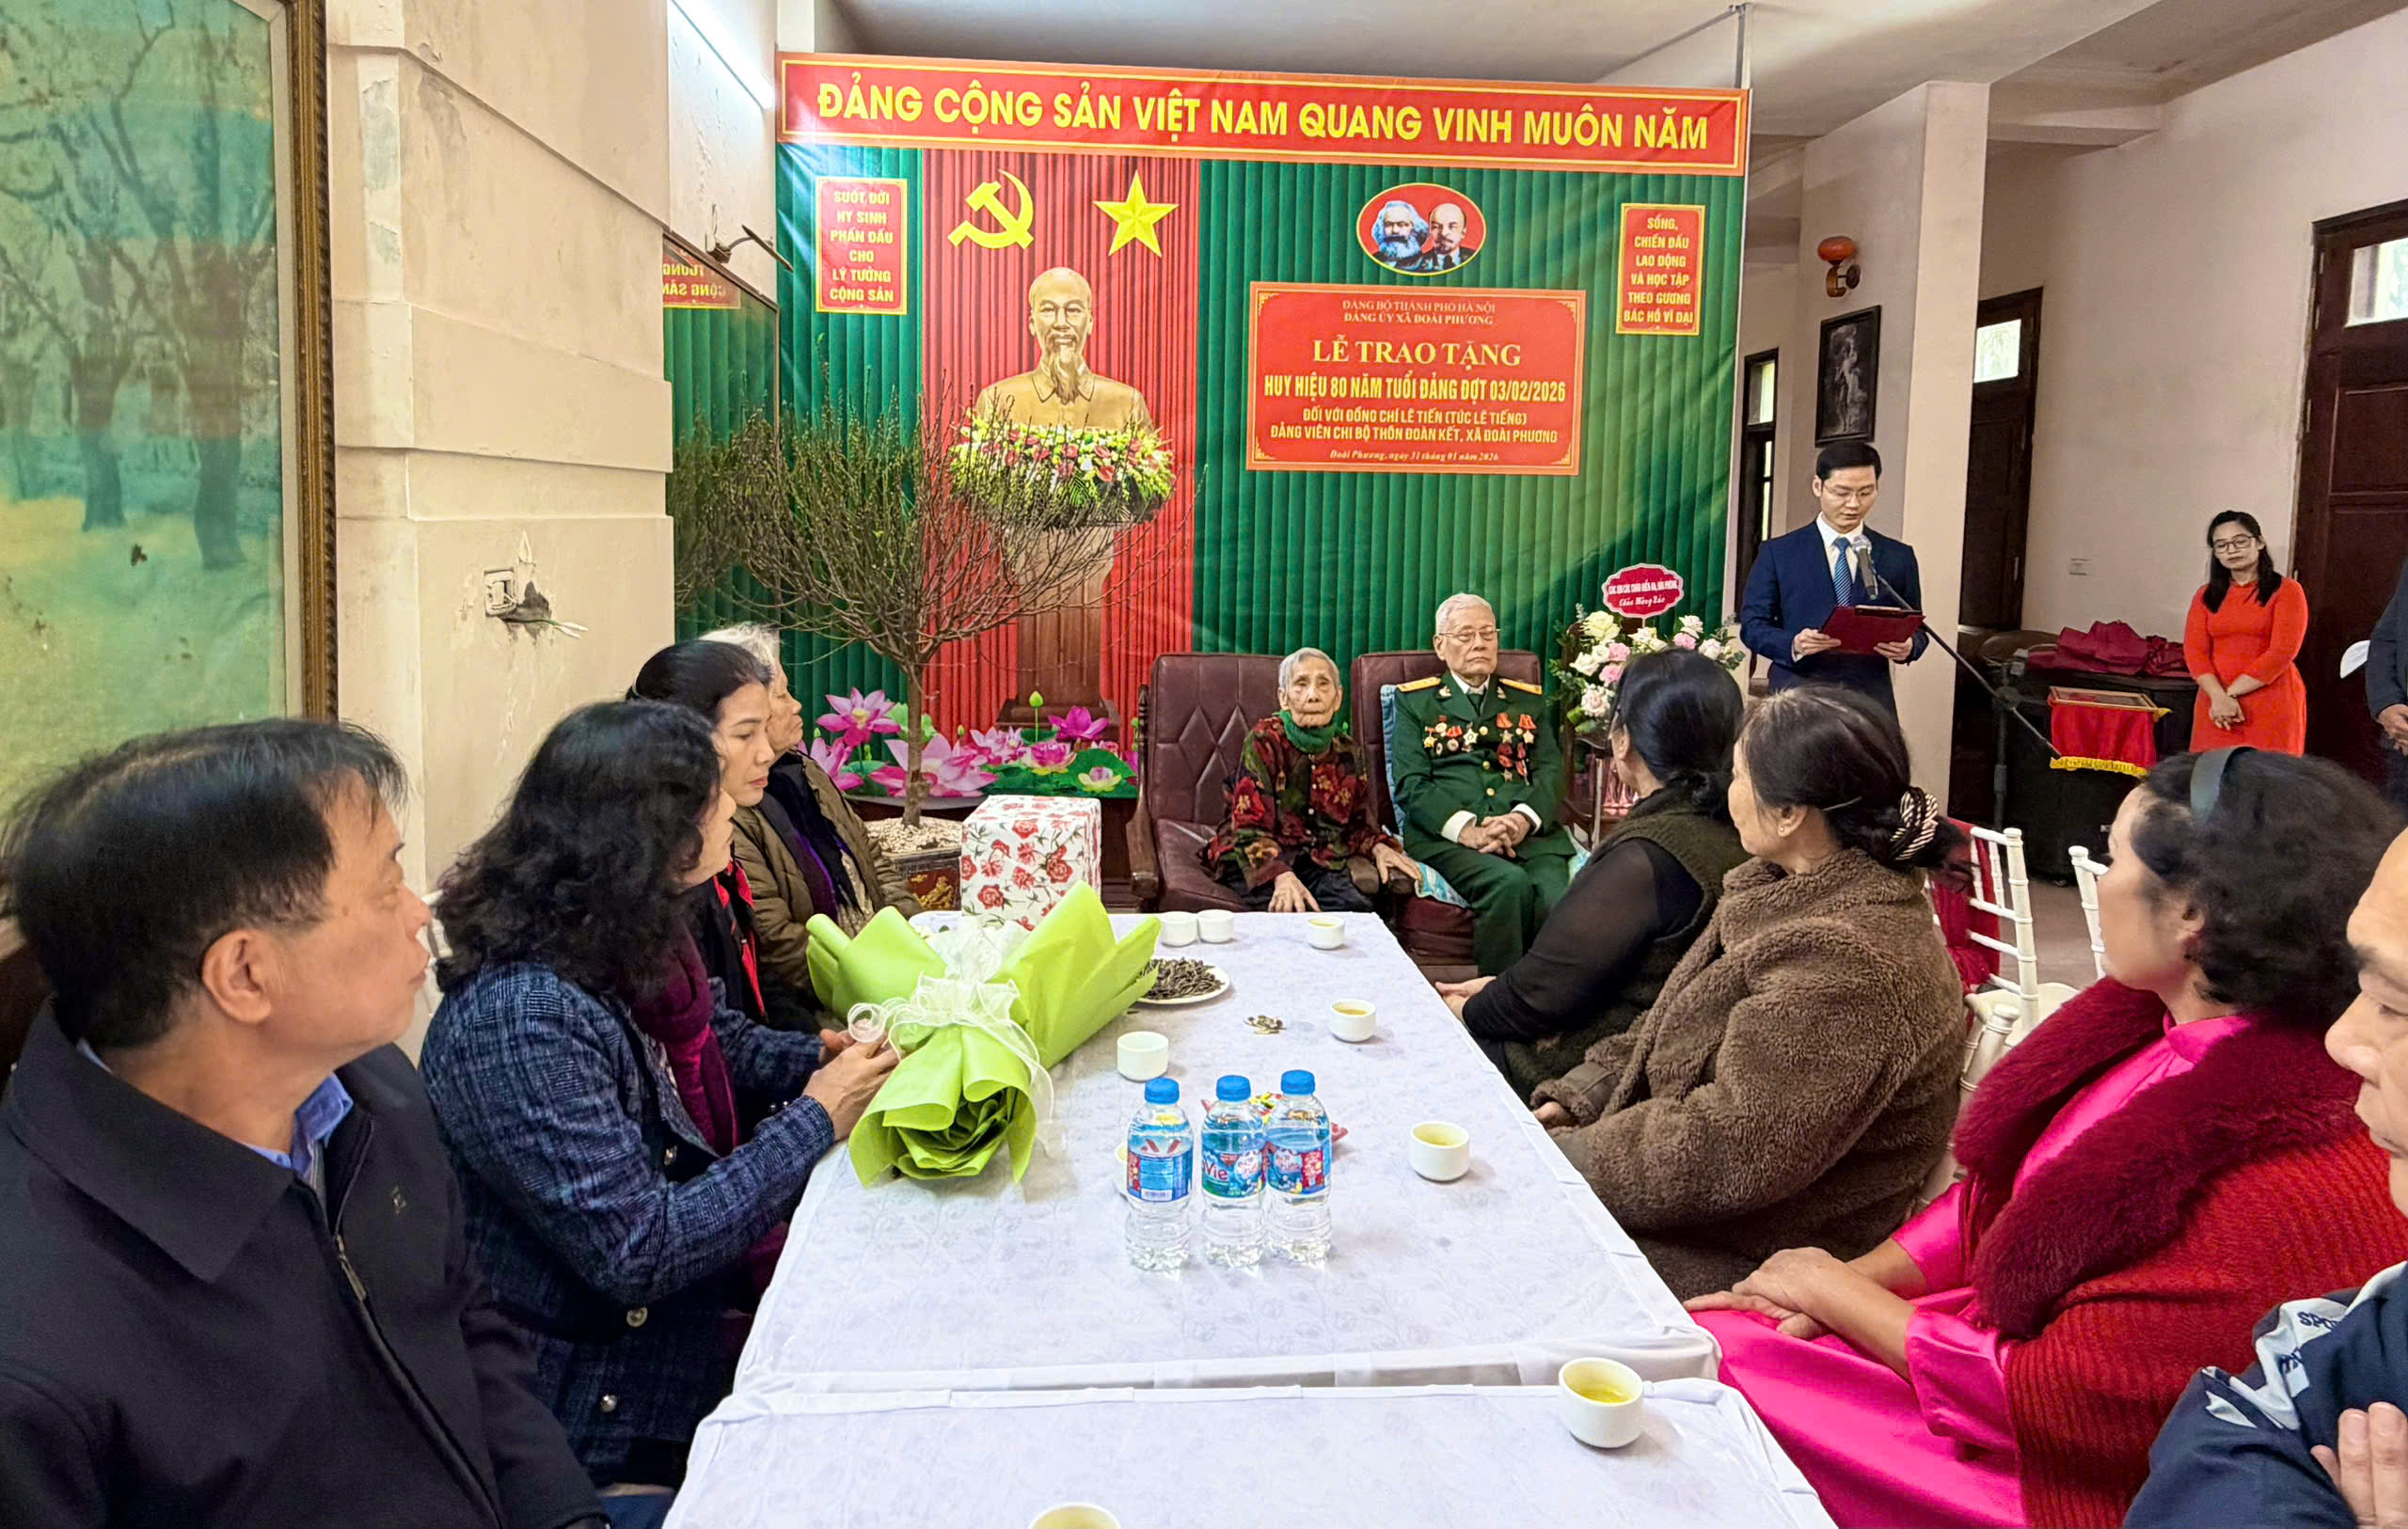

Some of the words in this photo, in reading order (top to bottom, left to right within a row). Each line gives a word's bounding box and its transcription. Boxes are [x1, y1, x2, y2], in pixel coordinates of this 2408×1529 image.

[818, 72, 923, 121] ĐẢNG
[934, 80, 1042, 134] CỘNG
[1054, 82, 1121, 130] SẢN
[1133, 88, 1200, 141] VIỆT
[1212, 99, 1287, 135] NAM
[1299, 102, 1422, 140] QUANG
[1433, 107, 1512, 143] VINH
[1524, 103, 1623, 148] MUÔN
[1634, 106, 1708, 150] NĂM
[834, 188, 865, 204] SUỐT
[836, 211, 852, 223] HY
[857, 211, 887, 225] SINH
[1647, 213, 1678, 230] SỐNG,
[830, 227, 864, 243] PHẤN
[868, 228, 894, 244] ĐẤU
[1634, 233, 1666, 248] CHIẾN
[1668, 233, 1689, 248] ĐẤU
[848, 249, 874, 262] CHO
[1636, 255, 1655, 267] LAO
[1657, 253, 1686, 269] ĐỘNG
[832, 266, 848, 280] LÝ
[850, 266, 891, 282] TƯỞNG
[1631, 271, 1644, 285] VÀ
[1647, 274, 1668, 287] HỌC
[1671, 272, 1689, 288] TẬP
[830, 286, 864, 303] CỘNG
[867, 285, 894, 302] SẢN
[1628, 292, 1654, 304] THEO
[1656, 292, 1691, 305] GƯƠNG
[1414, 311, 1442, 324] ĐOÀI
[1624, 307, 1644, 322] BÁC
[1647, 307, 1661, 323] HỒ
[1676, 311, 1693, 325] ĐẠI
[1313, 334, 1349, 362] LỄ
[1355, 341, 1436, 364] TRAO
[1441, 340, 1521, 371] TẶNG
[1264, 374, 1292, 397] HUY
[1295, 371, 1327, 402] HIỆU
[1330, 376, 1347, 398] 80
[1351, 372, 1382, 399] NĂM
[1386, 370, 1417, 399] TUỔI
[1419, 371, 1457, 400] ĐẢNG
[1461, 377, 1487, 404] ĐỢT
[1490, 379, 1565, 402] 03/02/2026
[1303, 404, 1323, 421] ĐỐI
[1324, 405, 1343, 421] VỚI
[1379, 407, 1399, 422] CHÍ
[1401, 408, 1415, 423] LÊ
[1417, 407, 1443, 423] TIẾN
[1473, 409, 1486, 425] LÊ
[1271, 421, 1302, 438] ĐẢNG
[1305, 423, 1331, 439] VIÊN
[1333, 426, 1353, 439] CHI
[1354, 424, 1370, 442] BỘ
[1372, 426, 1402, 440] THÔN
[1405, 425, 1435, 440] ĐOÀN
[1466, 426, 1481, 441] XÃ
[1483, 427, 1511, 442] ĐOÀI
[1513, 429, 1559, 443] PHƯƠNG
